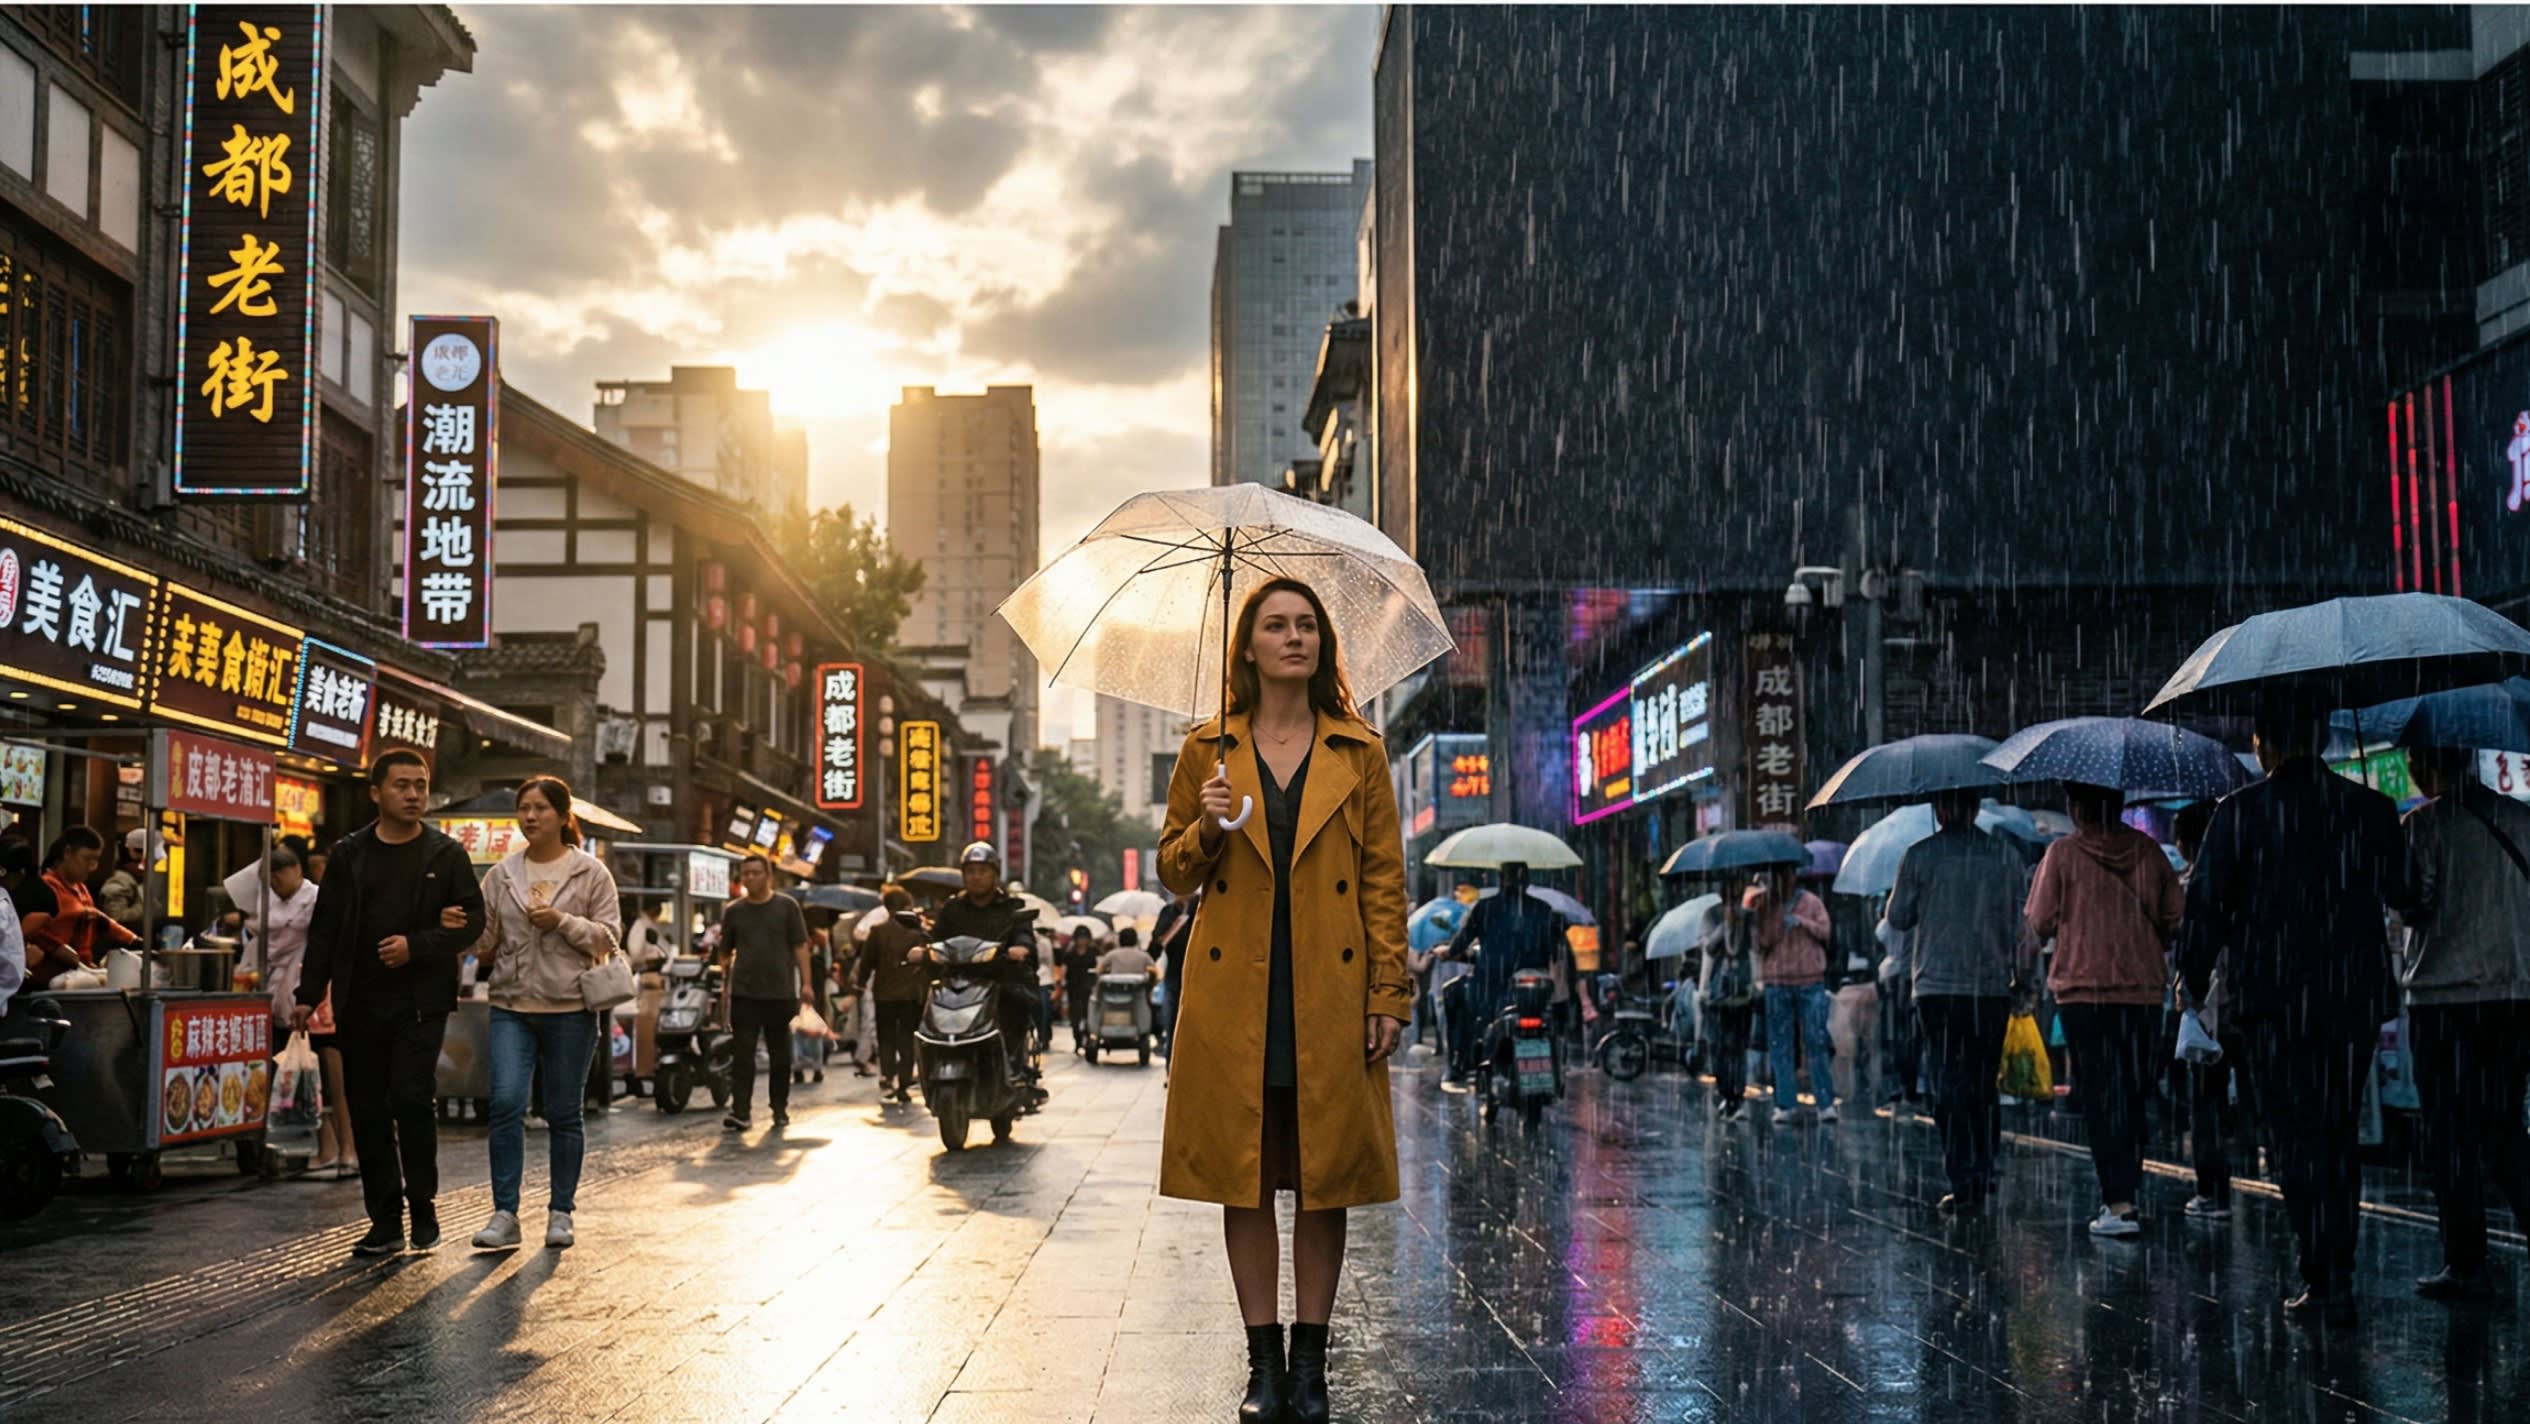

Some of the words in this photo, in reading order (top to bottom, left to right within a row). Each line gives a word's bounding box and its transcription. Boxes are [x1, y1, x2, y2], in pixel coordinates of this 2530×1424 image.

[201, 20, 295, 423] 成都老街
[419, 402, 476, 625] 潮流地带
[22, 559, 142, 663] 美食汇
[824, 669, 856, 800] 成都老街
[1755, 664, 1796, 816] 成都老街
